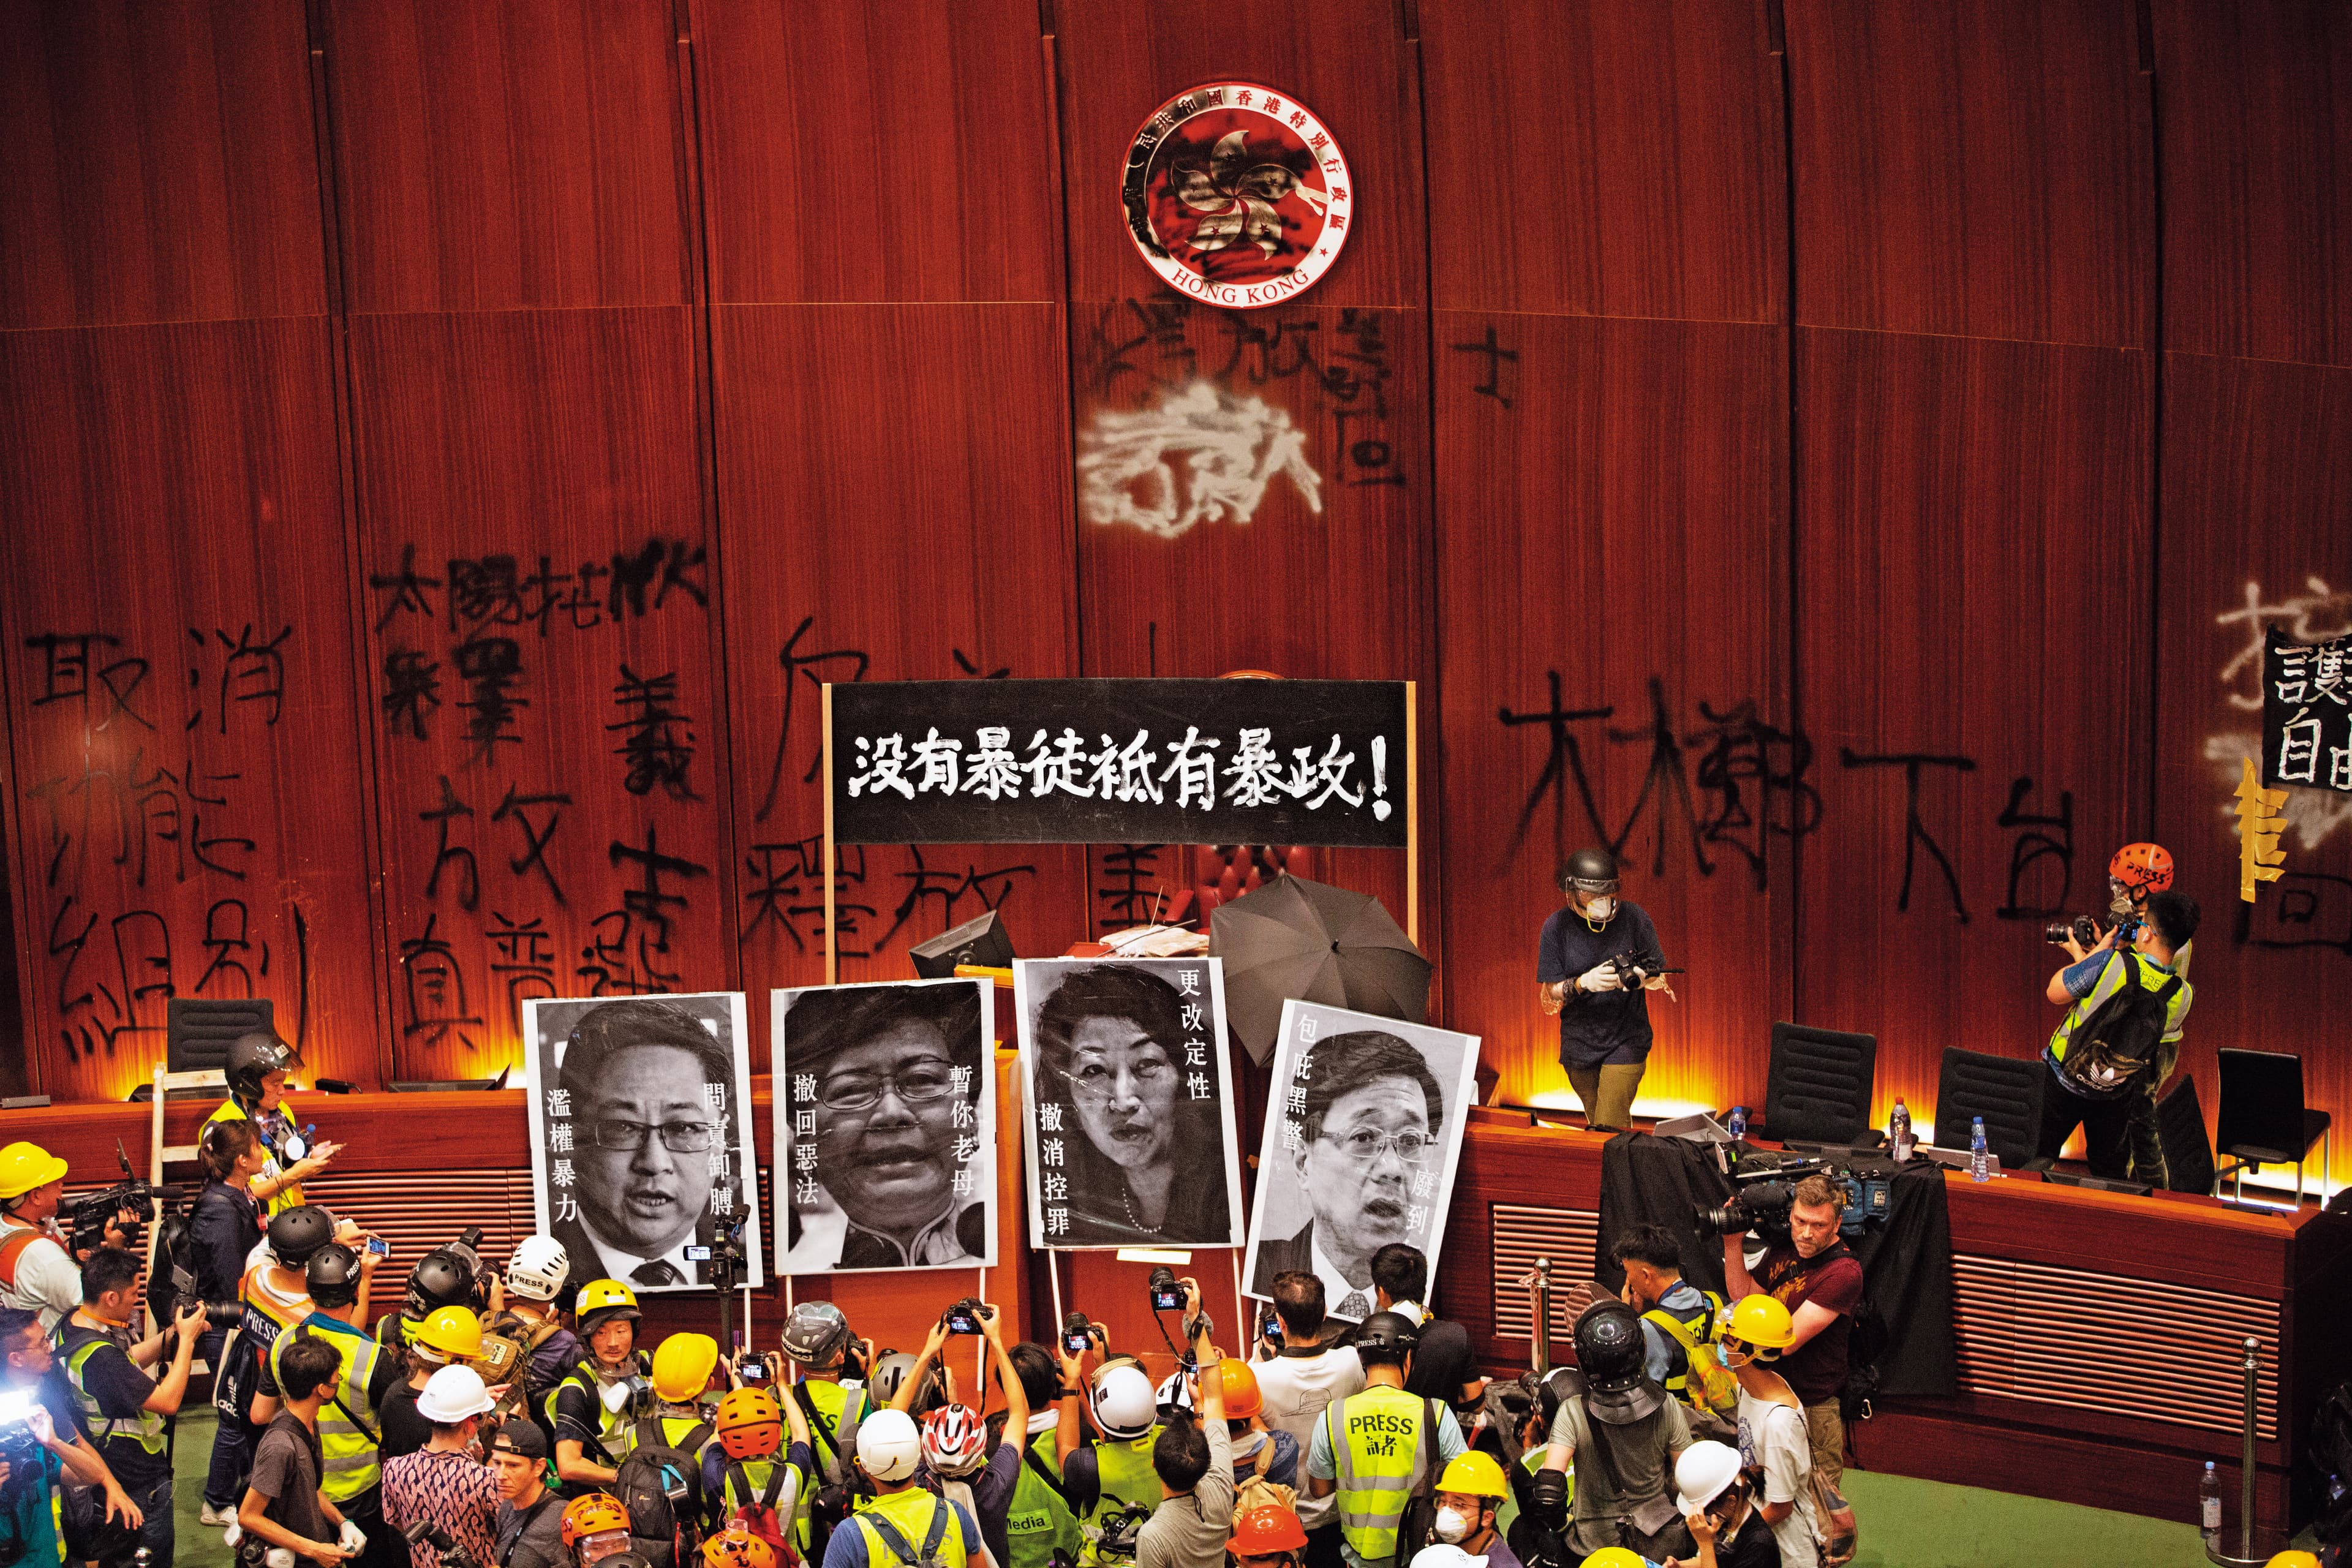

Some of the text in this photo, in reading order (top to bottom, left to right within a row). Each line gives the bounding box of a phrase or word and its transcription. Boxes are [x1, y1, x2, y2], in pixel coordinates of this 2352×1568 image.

[1171, 268, 1309, 304] HONG KONG
[24, 624, 292, 734] 取消
[2274, 637, 2352, 706] 護
[2126, 861, 2166, 884] PRESS
[1177, 968, 1212, 1101] 更改定性
[1282, 1013, 1318, 1151] 包庇黑警
[546, 1088, 579, 1224] 濫權暴力
[703, 1082, 734, 1216] 問責卸膊
[793, 1074, 820, 1205] 撤回惡法
[949, 1065, 974, 1198] 暫你老母
[1039, 1103, 1071, 1237] 撤消控罪
[1404, 1167, 1434, 1250] 廢到
[514, 1273, 544, 1287] PRESS
[1350, 1414, 1414, 1435] PRESS
[577, 1502, 622, 1520] PRESS
